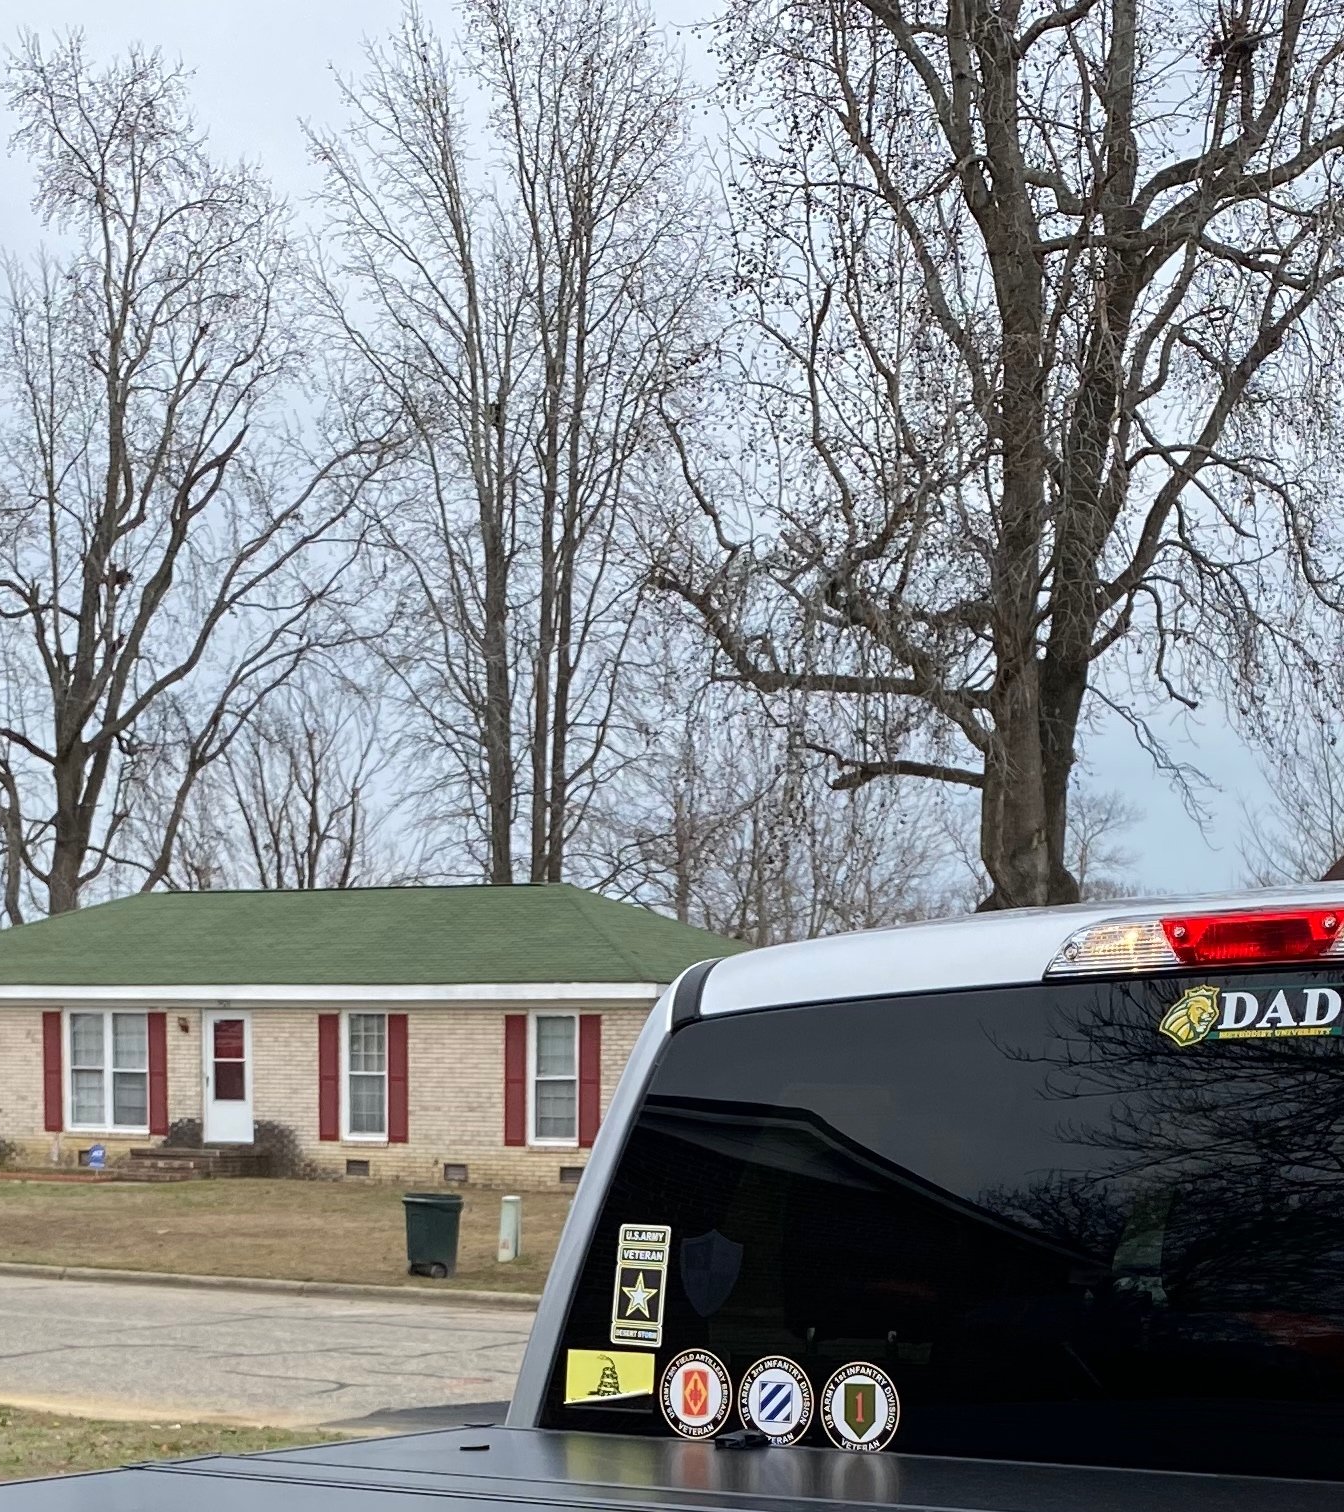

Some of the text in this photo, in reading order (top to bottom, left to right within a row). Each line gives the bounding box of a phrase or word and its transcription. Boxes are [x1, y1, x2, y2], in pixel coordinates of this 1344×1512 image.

[1218, 988, 1342, 1030] DAD
[623, 1249, 664, 1261] VETERAN
[675, 1353, 695, 1368] FIELD
[695, 1353, 727, 1382] ARTILLERY
[663, 1381, 671, 1406] ARMY
[716, 1383, 728, 1421] BRIGADE
[741, 1359, 811, 1426] US ARMY 3rd INFANTRY DIVISION
[823, 1365, 896, 1432] US ARMY 1st INFANTRY DIVISION
[666, 1406, 675, 1419] US
[856, 1391, 865, 1424] 1
[678, 1421, 715, 1436] VETERAN
